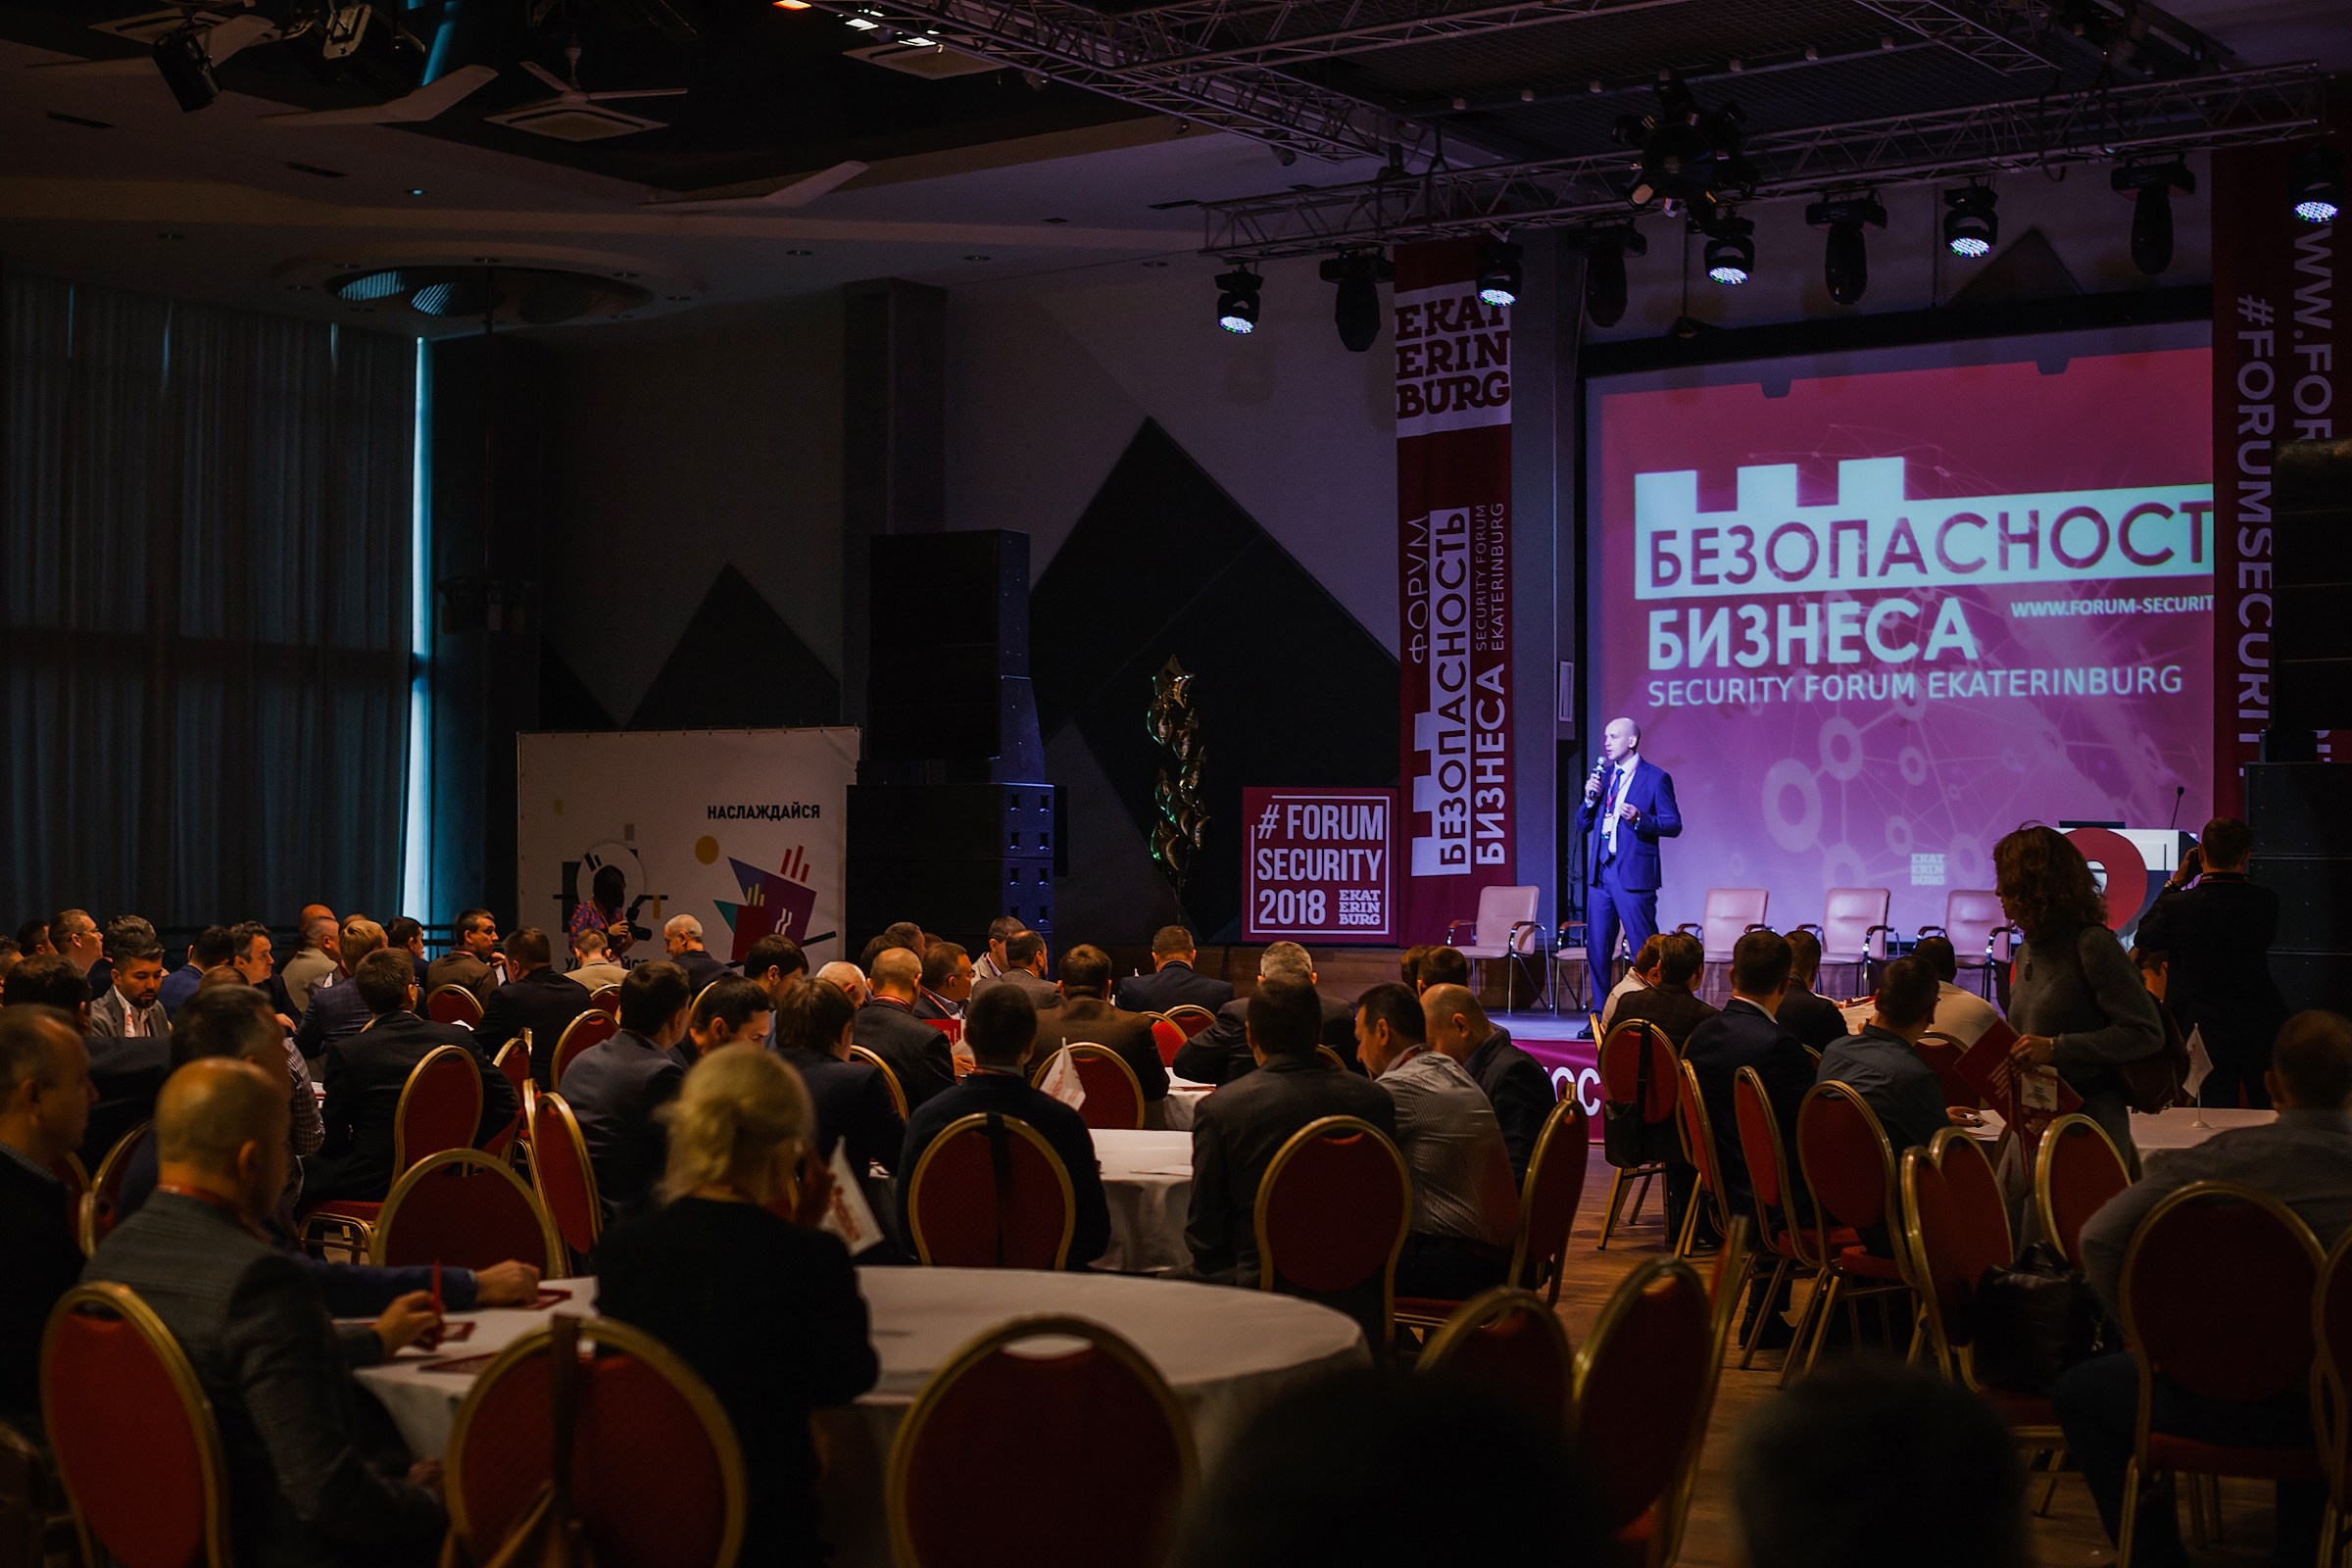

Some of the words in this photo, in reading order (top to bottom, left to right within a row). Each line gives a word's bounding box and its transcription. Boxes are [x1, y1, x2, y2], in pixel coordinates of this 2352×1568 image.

[1396, 296, 1504, 340] EKAT
[1396, 330, 1509, 379] ERIN
[1396, 370, 1509, 418] BURG
[1475, 505, 1487, 563] FORUM
[2237, 295, 2275, 776] #FORUMSECURI
[1406, 515, 1429, 663] ФОРУМ
[1491, 503, 1504, 651] EKATERINBURG
[1475, 570, 1487, 652] SECURITY
[1648, 598, 1979, 670] БИЗНЕСА
[1436, 513, 1466, 864] БЕЗОПАСНОСТЬ
[1648, 676, 1793, 707] SECURITY
[1805, 673, 1914, 703] FORUM
[1928, 665, 2181, 699] EKATERINBURG
[1475, 662, 1506, 865] БИЗНЕСА
[707, 802, 820, 820] НАСЛАЖДАЙСЯ
[1287, 805, 1384, 840] FORUM
[1256, 848, 1384, 882] SECURITY
[1258, 889, 1327, 925] 2018
[1339, 890, 1381, 902] EKAT
[1339, 902, 1381, 913] ERIN
[1339, 913, 1381, 925] BURG
